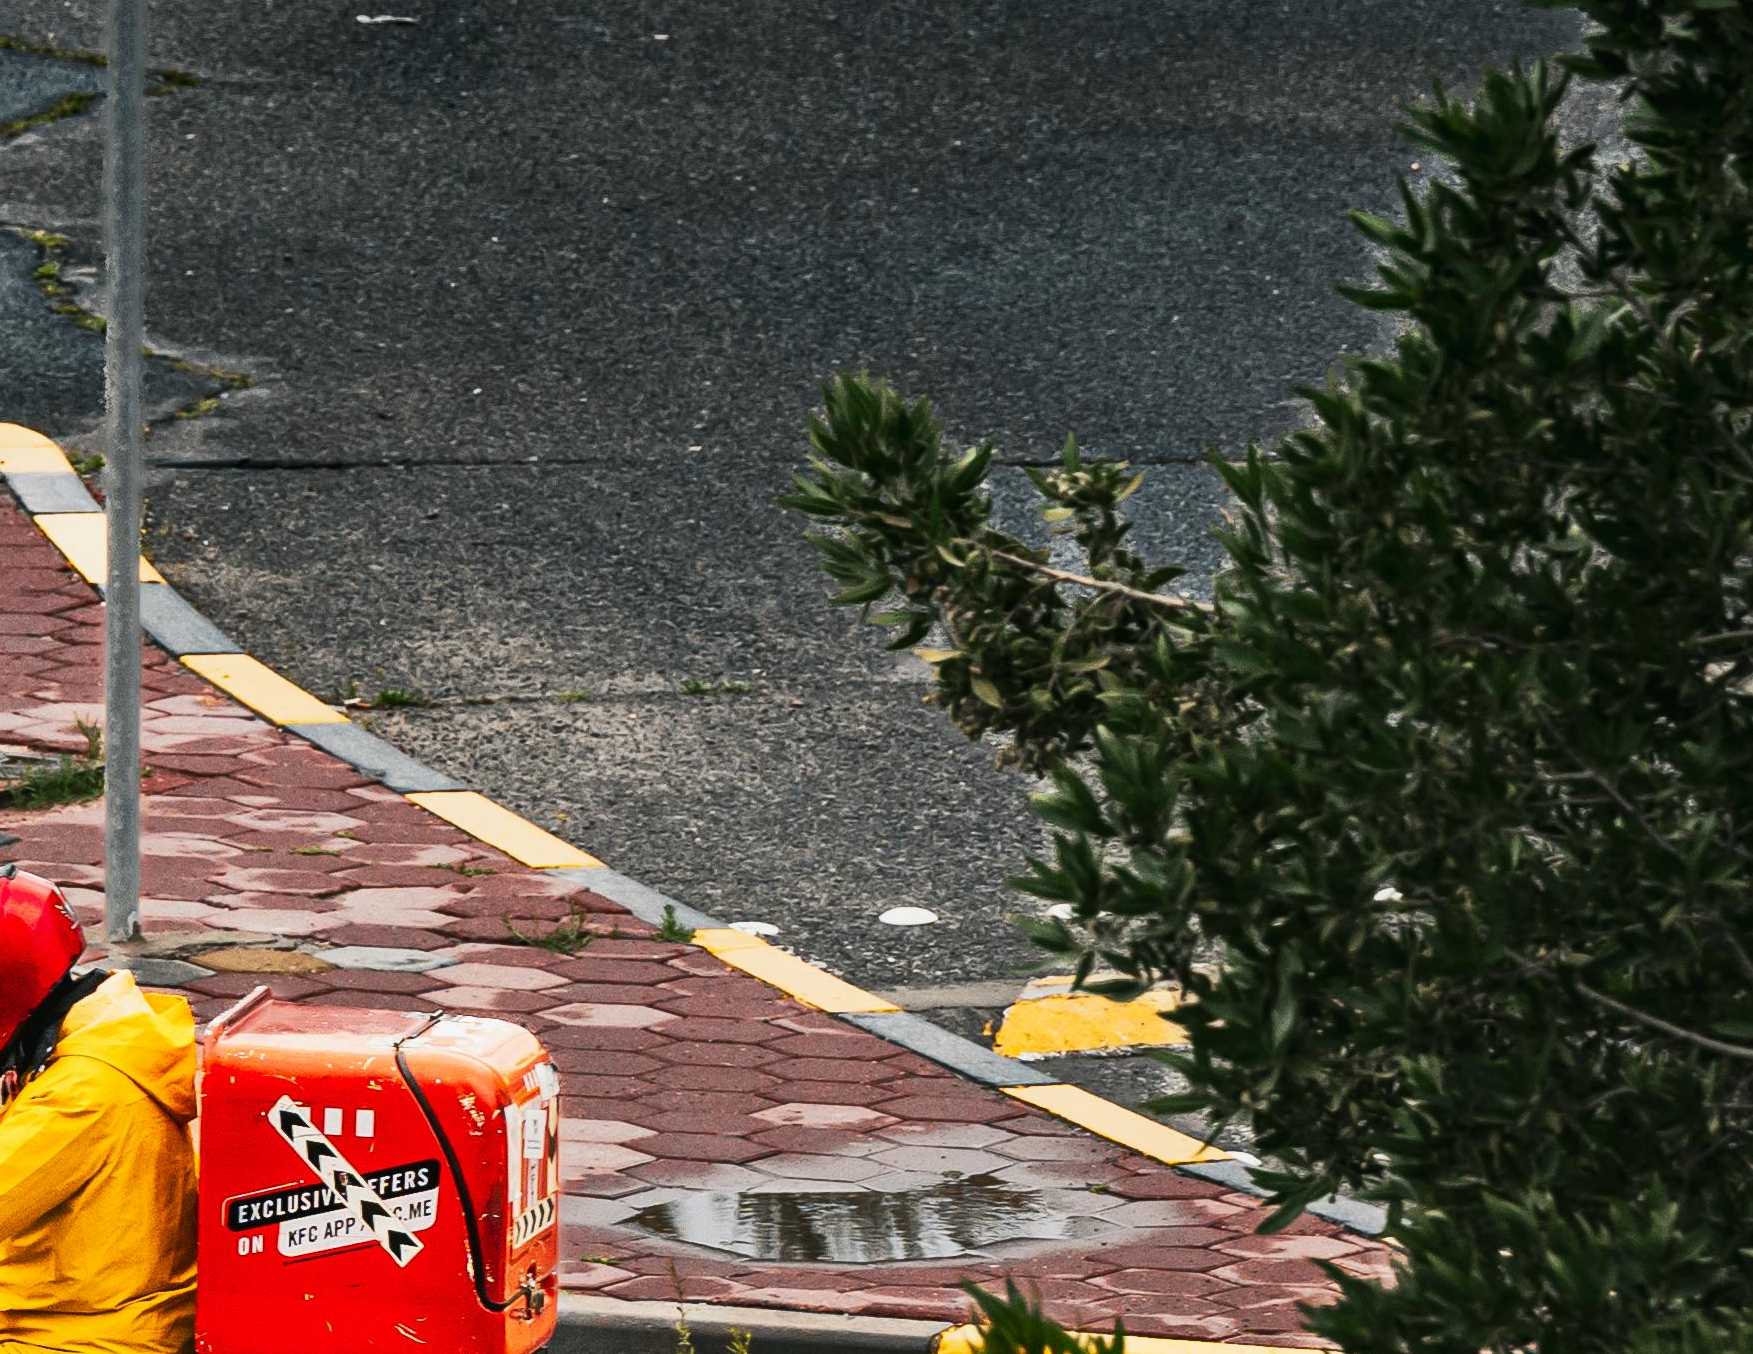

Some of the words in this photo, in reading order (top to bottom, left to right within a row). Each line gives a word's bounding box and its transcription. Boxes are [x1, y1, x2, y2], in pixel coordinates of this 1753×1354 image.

[367, 1167, 429, 1195] FFERS
[237, 1234, 264, 1256] ON
[288, 1225, 318, 1248] KFC
[323, 1217, 356, 1240] APP
